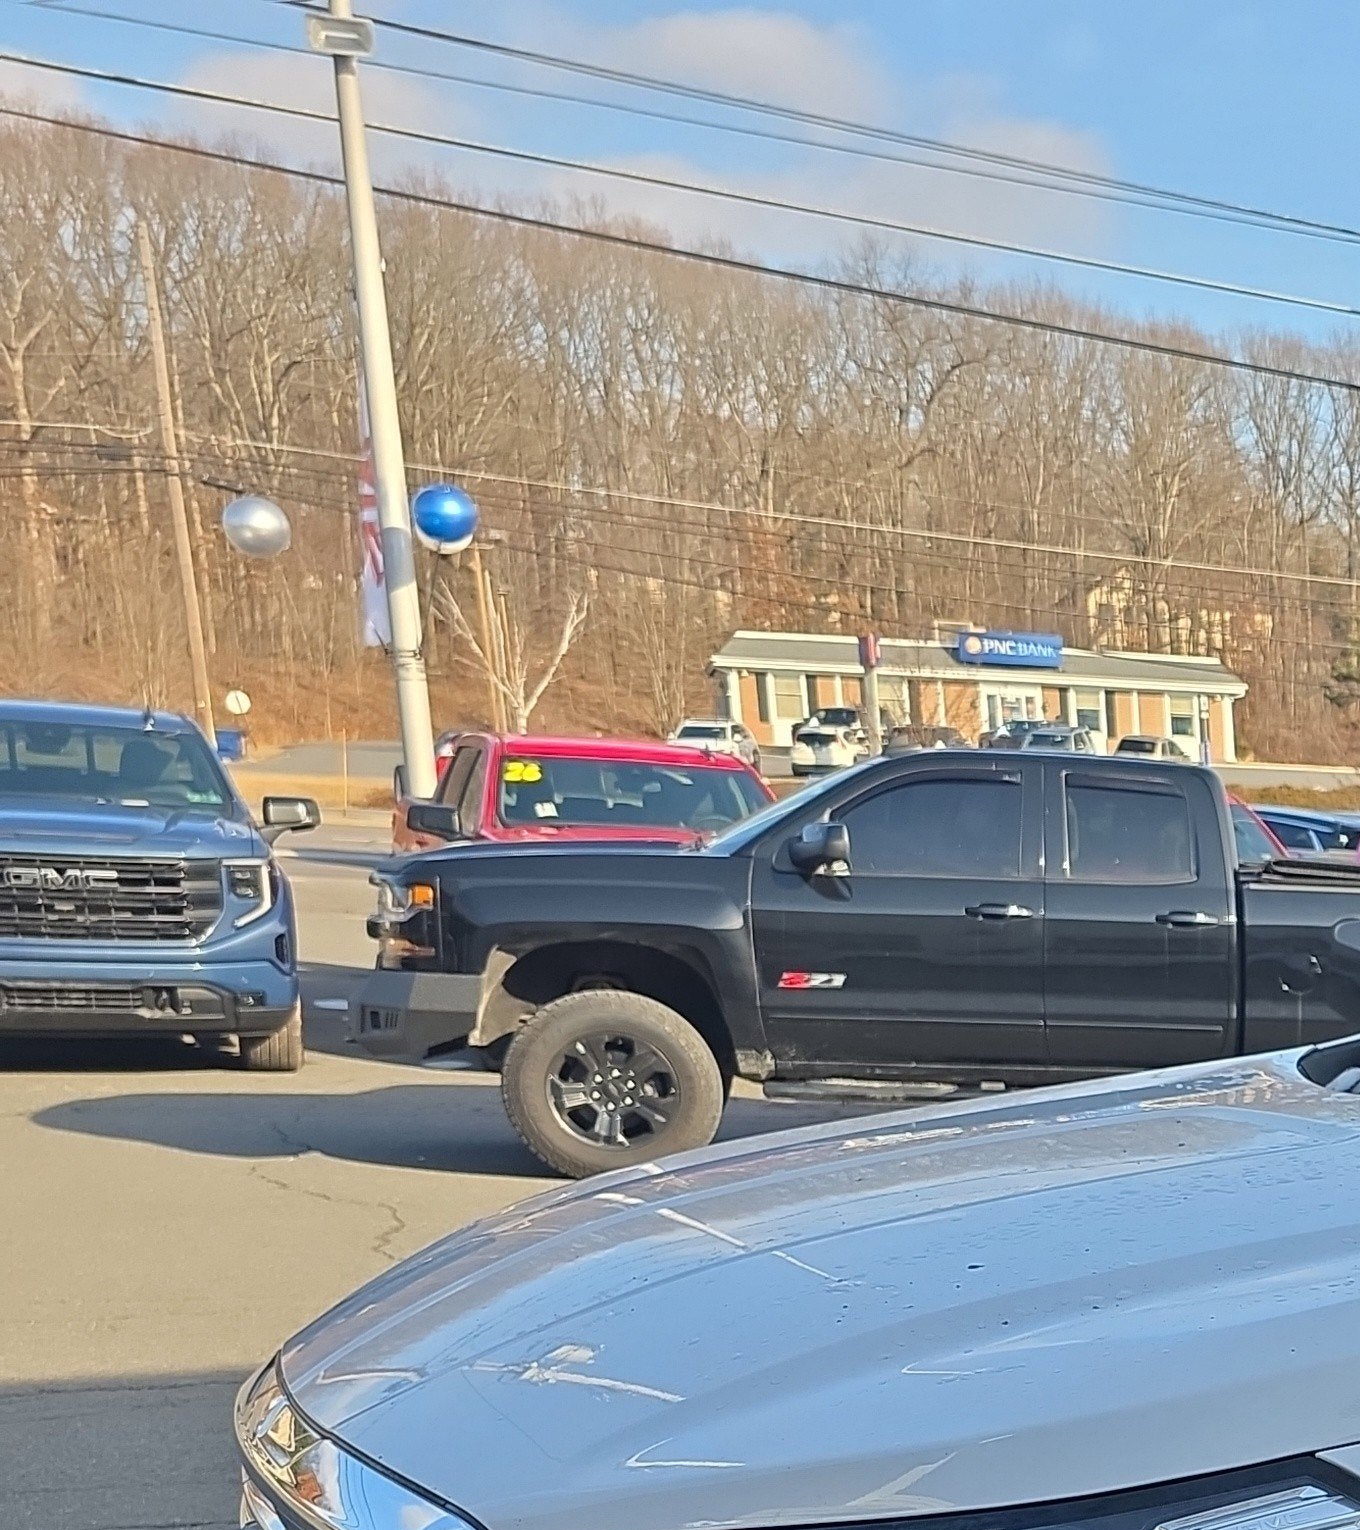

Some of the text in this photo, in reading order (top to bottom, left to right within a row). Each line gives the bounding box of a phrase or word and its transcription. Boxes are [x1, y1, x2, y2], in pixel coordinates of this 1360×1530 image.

[982, 638, 1058, 658] PNC BANK
[4, 866, 119, 890] GMC
[777, 971, 848, 988] Z71
